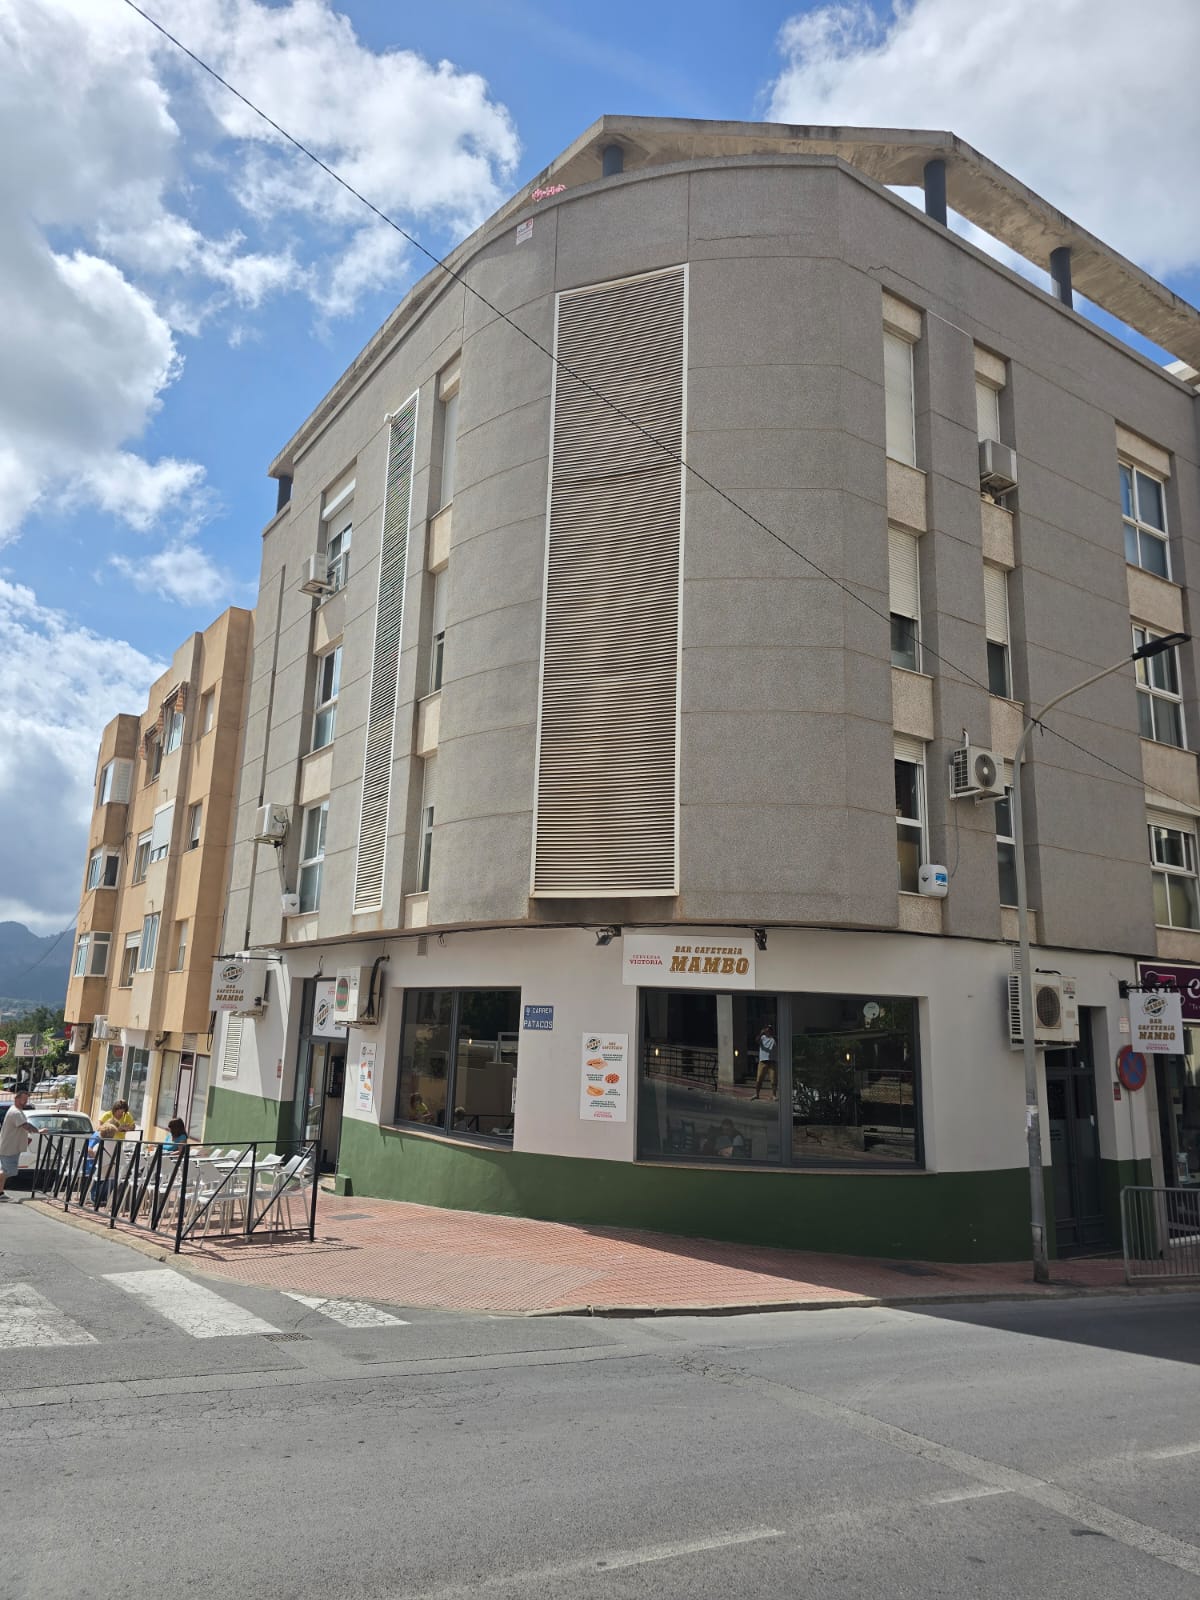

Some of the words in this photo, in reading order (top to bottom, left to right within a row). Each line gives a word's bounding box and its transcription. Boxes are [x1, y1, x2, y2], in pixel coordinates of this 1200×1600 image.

[674, 945, 692, 953] BAR
[669, 956, 749, 975] MAMBO
[215, 994, 244, 1002] MAMBO
[523, 1019, 553, 1029] PATACOS
[1139, 1031, 1176, 1040] MAMBO
